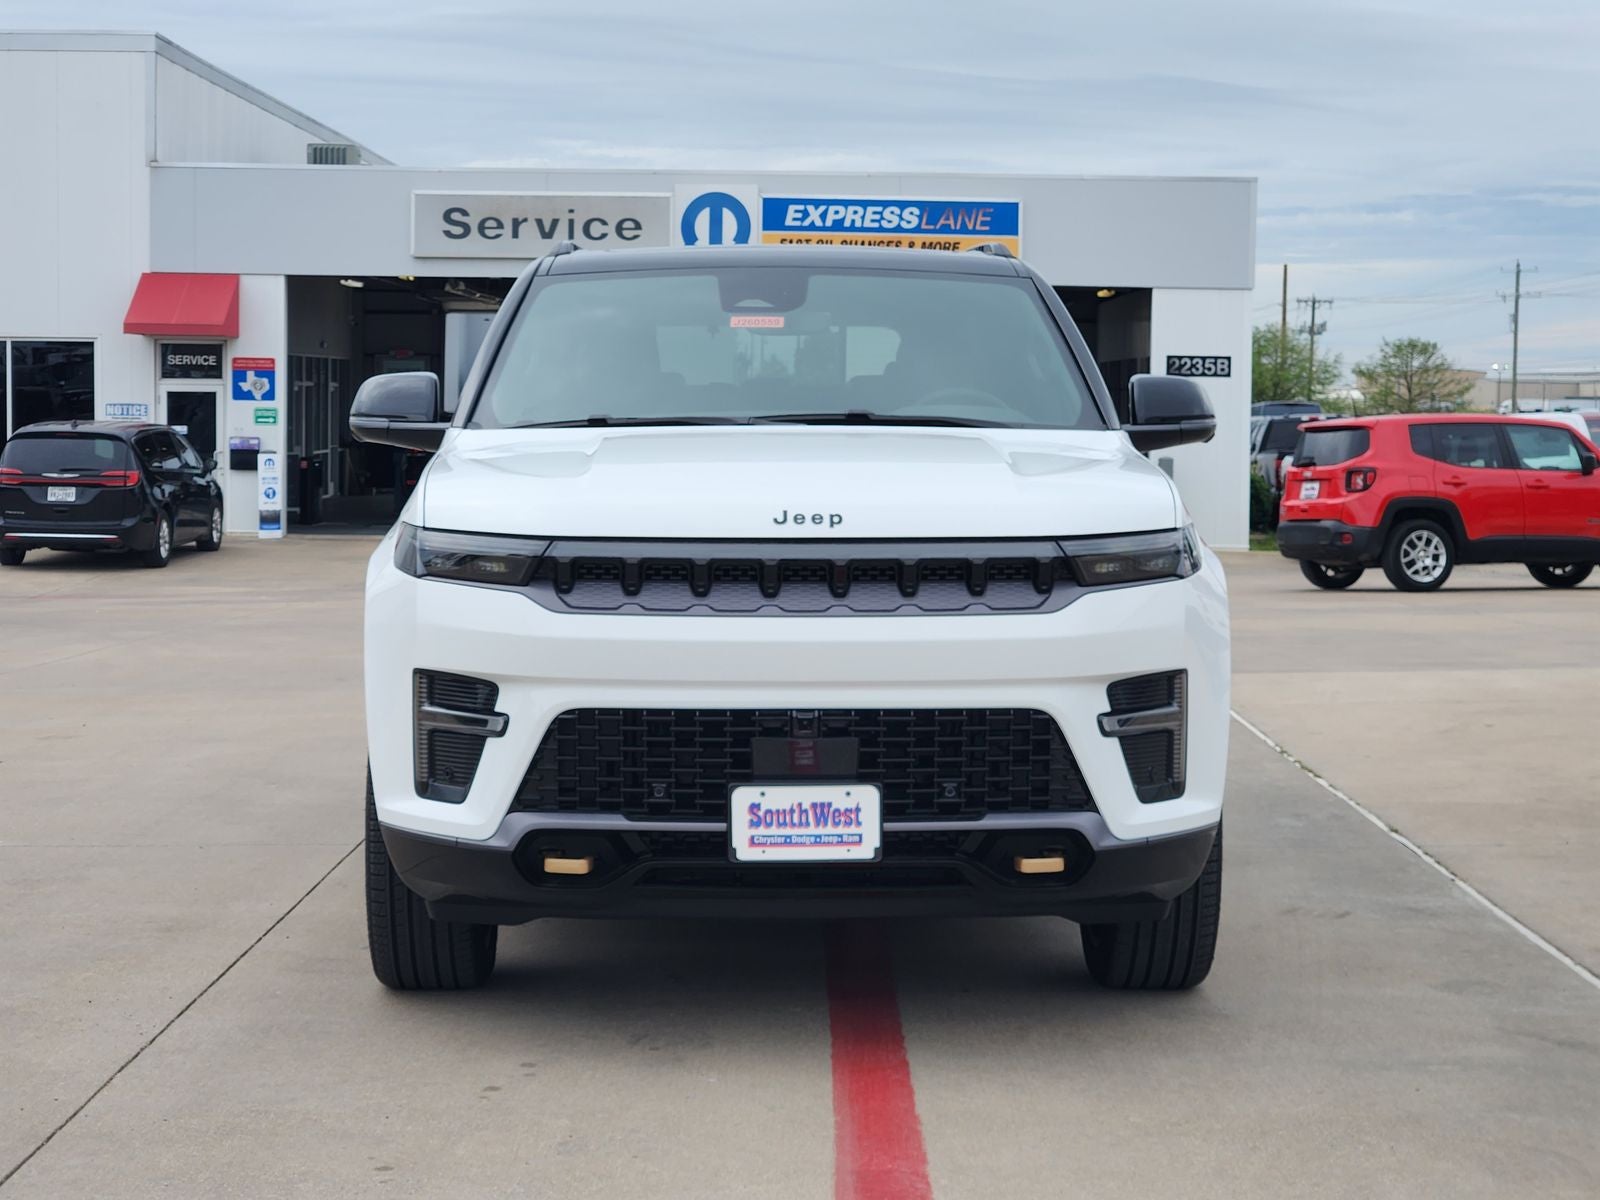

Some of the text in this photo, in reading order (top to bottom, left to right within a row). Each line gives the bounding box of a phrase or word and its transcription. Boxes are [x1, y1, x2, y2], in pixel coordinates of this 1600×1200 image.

[442, 207, 643, 241] Service
[167, 354, 217, 366] SERVICE
[1168, 357, 1230, 376] 2235B
[106, 404, 148, 416] NOTICE
[772, 509, 843, 529] Jeep
[747, 801, 863, 830] SouthWest
[753, 834, 860, 845] Chrysler Dodge Jeep Ram
